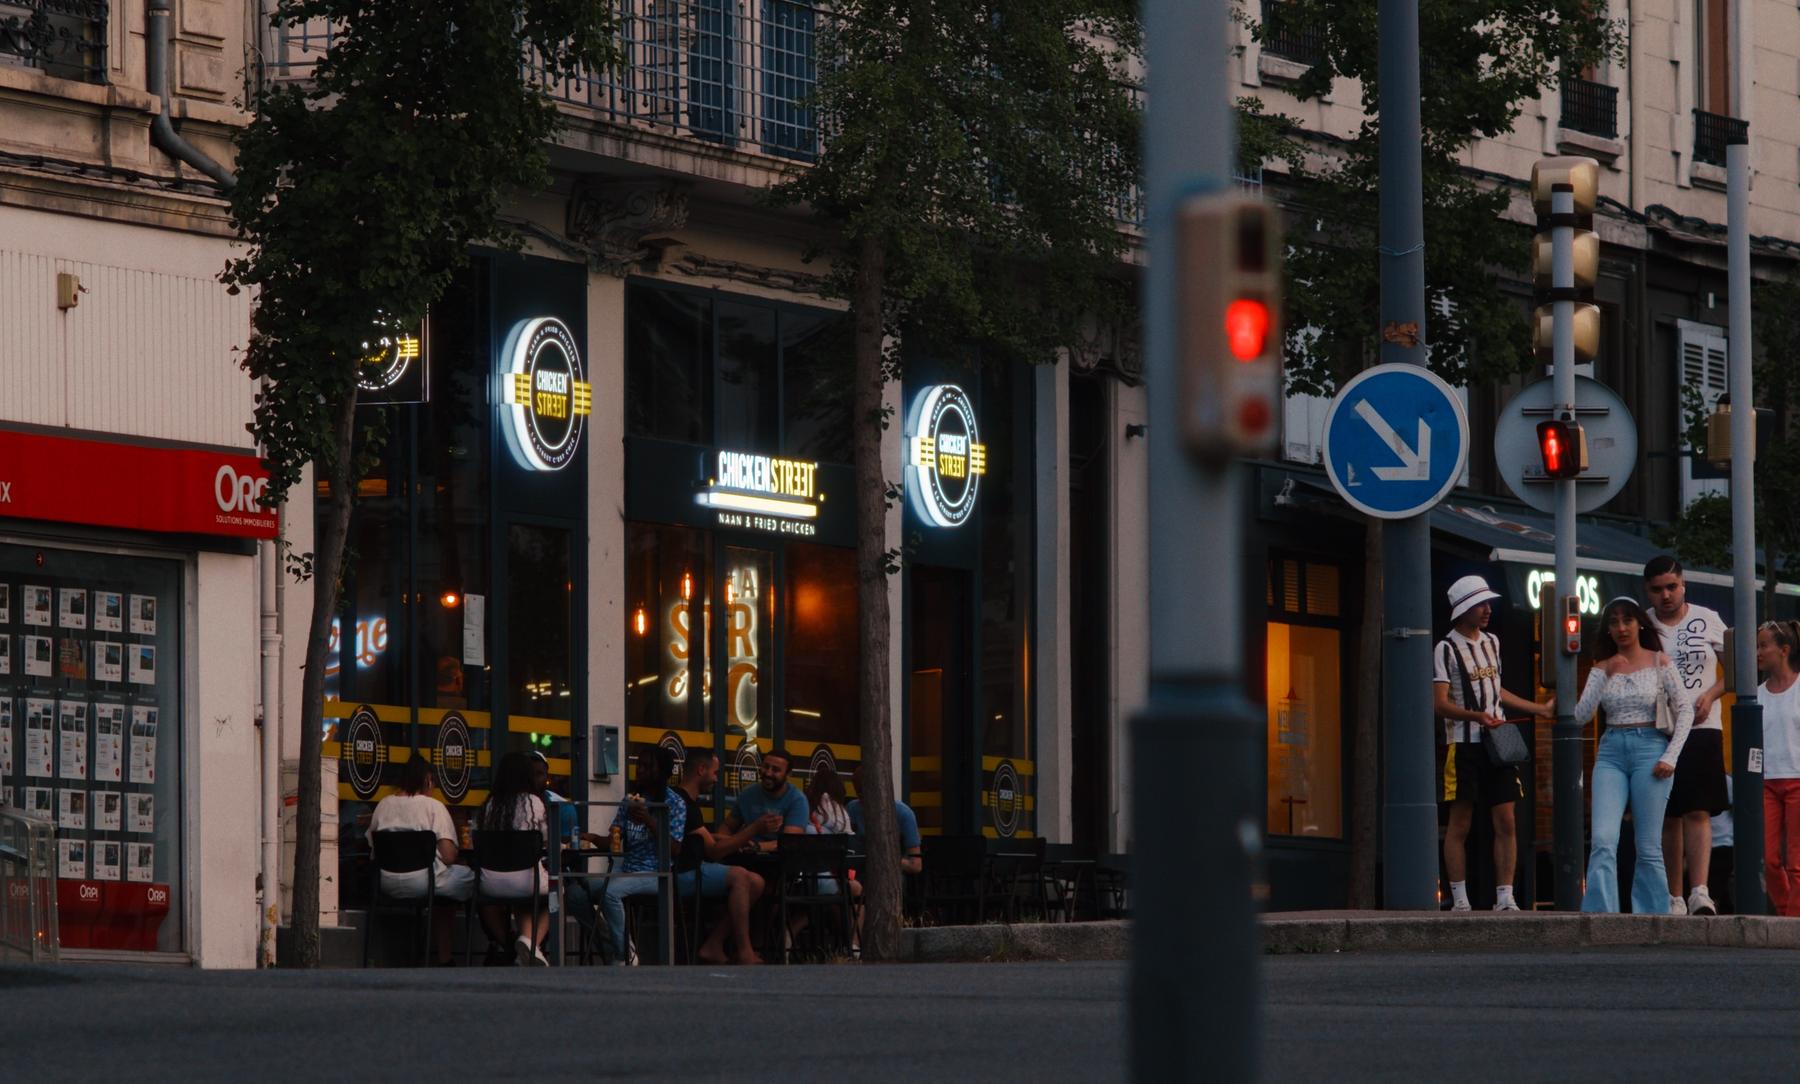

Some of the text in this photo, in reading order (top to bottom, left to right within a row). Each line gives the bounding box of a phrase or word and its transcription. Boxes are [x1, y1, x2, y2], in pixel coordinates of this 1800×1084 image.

[536, 370, 567, 393] CHICKEN
[939, 433, 966, 455] CHICKEN
[0, 480, 12, 503] X
[719, 513, 816, 535] NAAN & FRIED CHICKEN
[1683, 618, 1707, 689] GUESS
[80, 884, 98, 899] ORPI
[147, 888, 166, 902] ORPI
